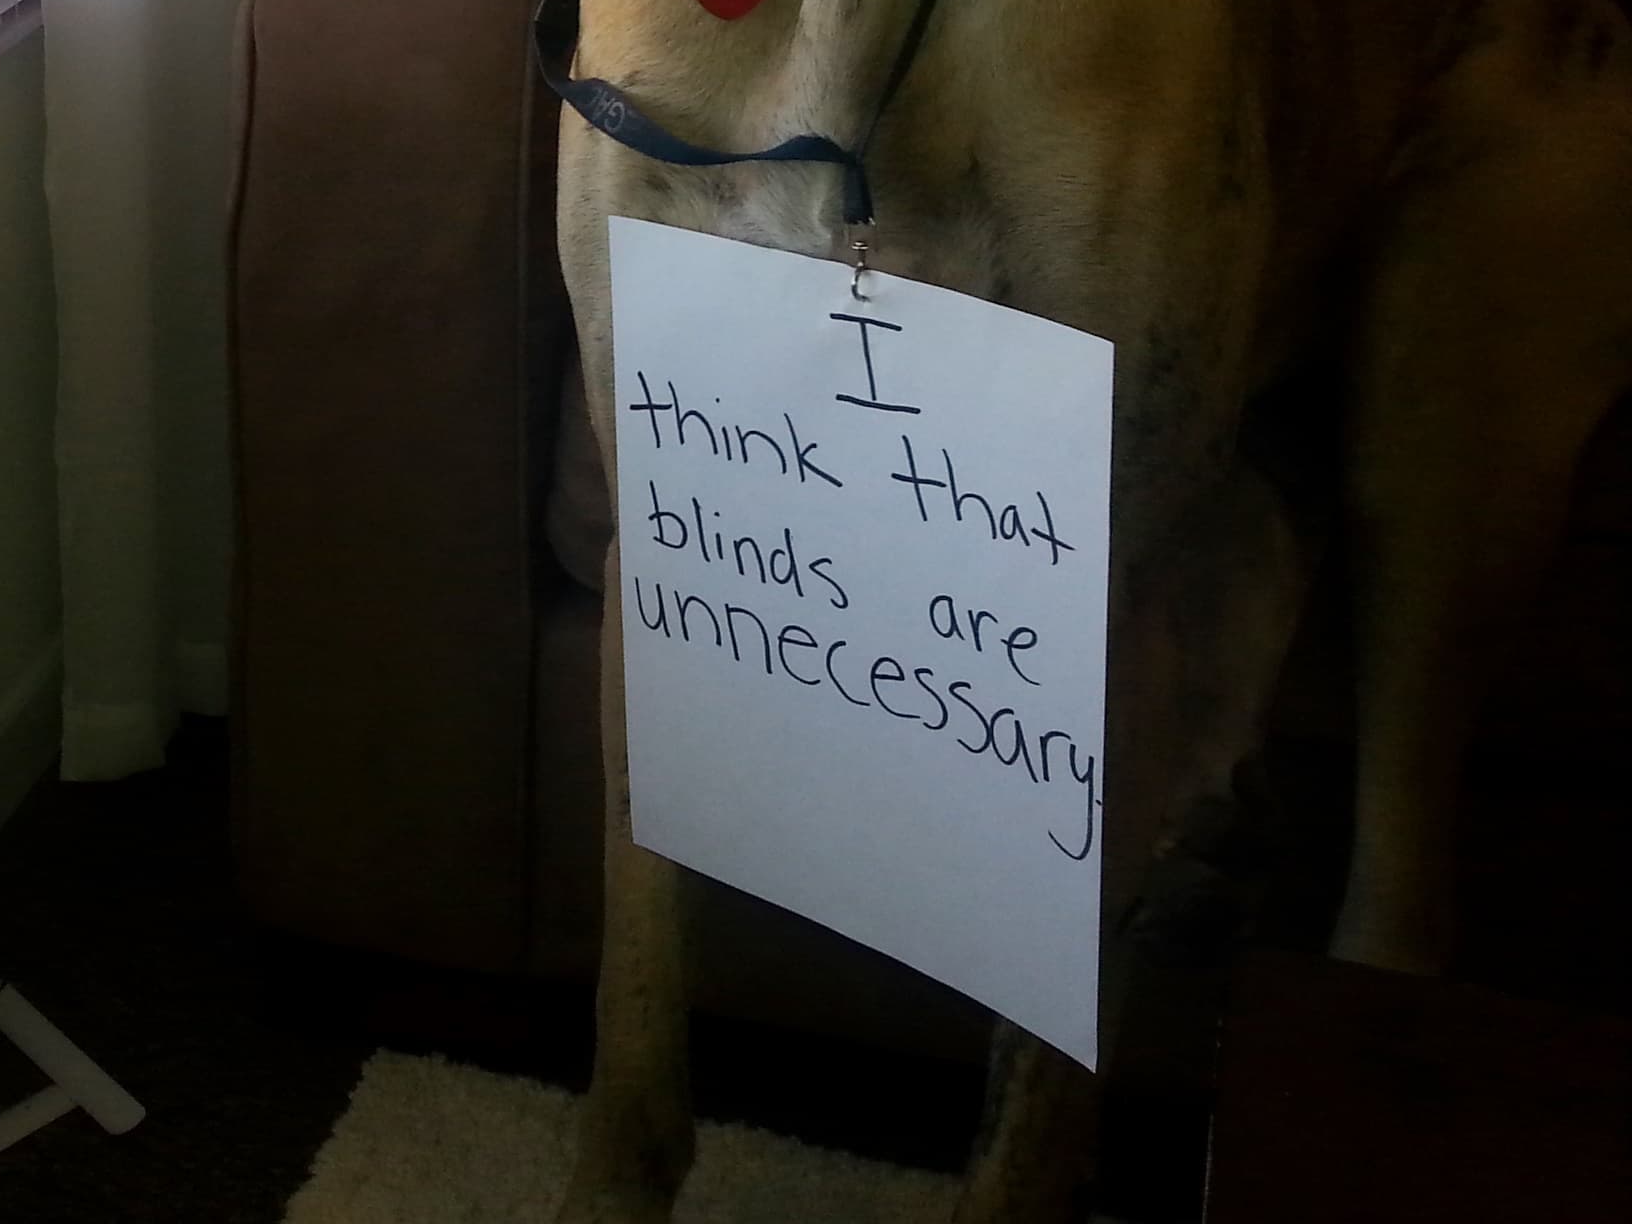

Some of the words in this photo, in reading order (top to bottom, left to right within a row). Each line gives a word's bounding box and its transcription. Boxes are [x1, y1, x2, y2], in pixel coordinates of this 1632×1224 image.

[830, 313, 921, 414] I
[630, 370, 843, 488] think
[891, 434, 1076, 566] that
[647, 479, 849, 610] blinds
[929, 594, 1041, 686] are
